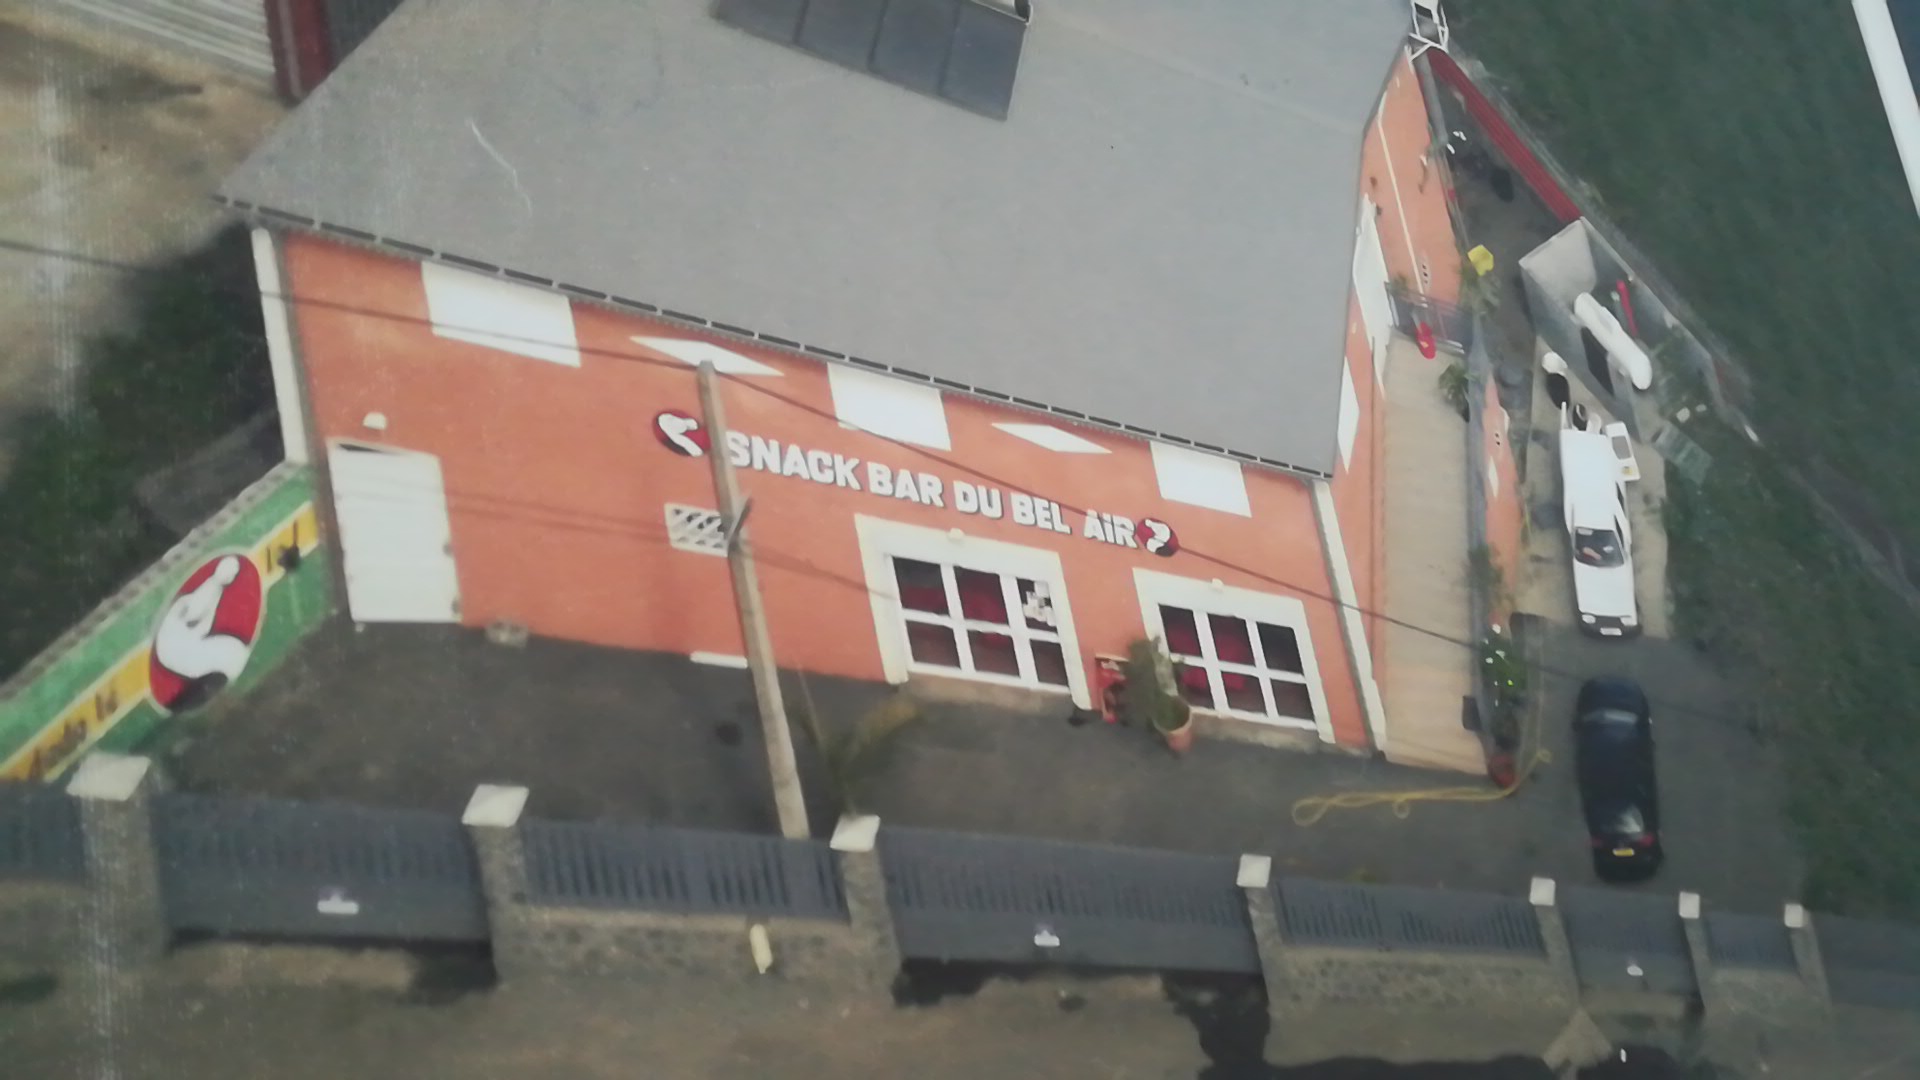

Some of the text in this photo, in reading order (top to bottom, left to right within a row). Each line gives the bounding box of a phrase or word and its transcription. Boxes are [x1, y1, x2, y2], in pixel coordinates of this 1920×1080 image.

[726, 431, 861, 490] SNACK
[867, 461, 944, 507] BAR
[953, 480, 1003, 519] DU
[1010, 491, 1071, 534] BEL
